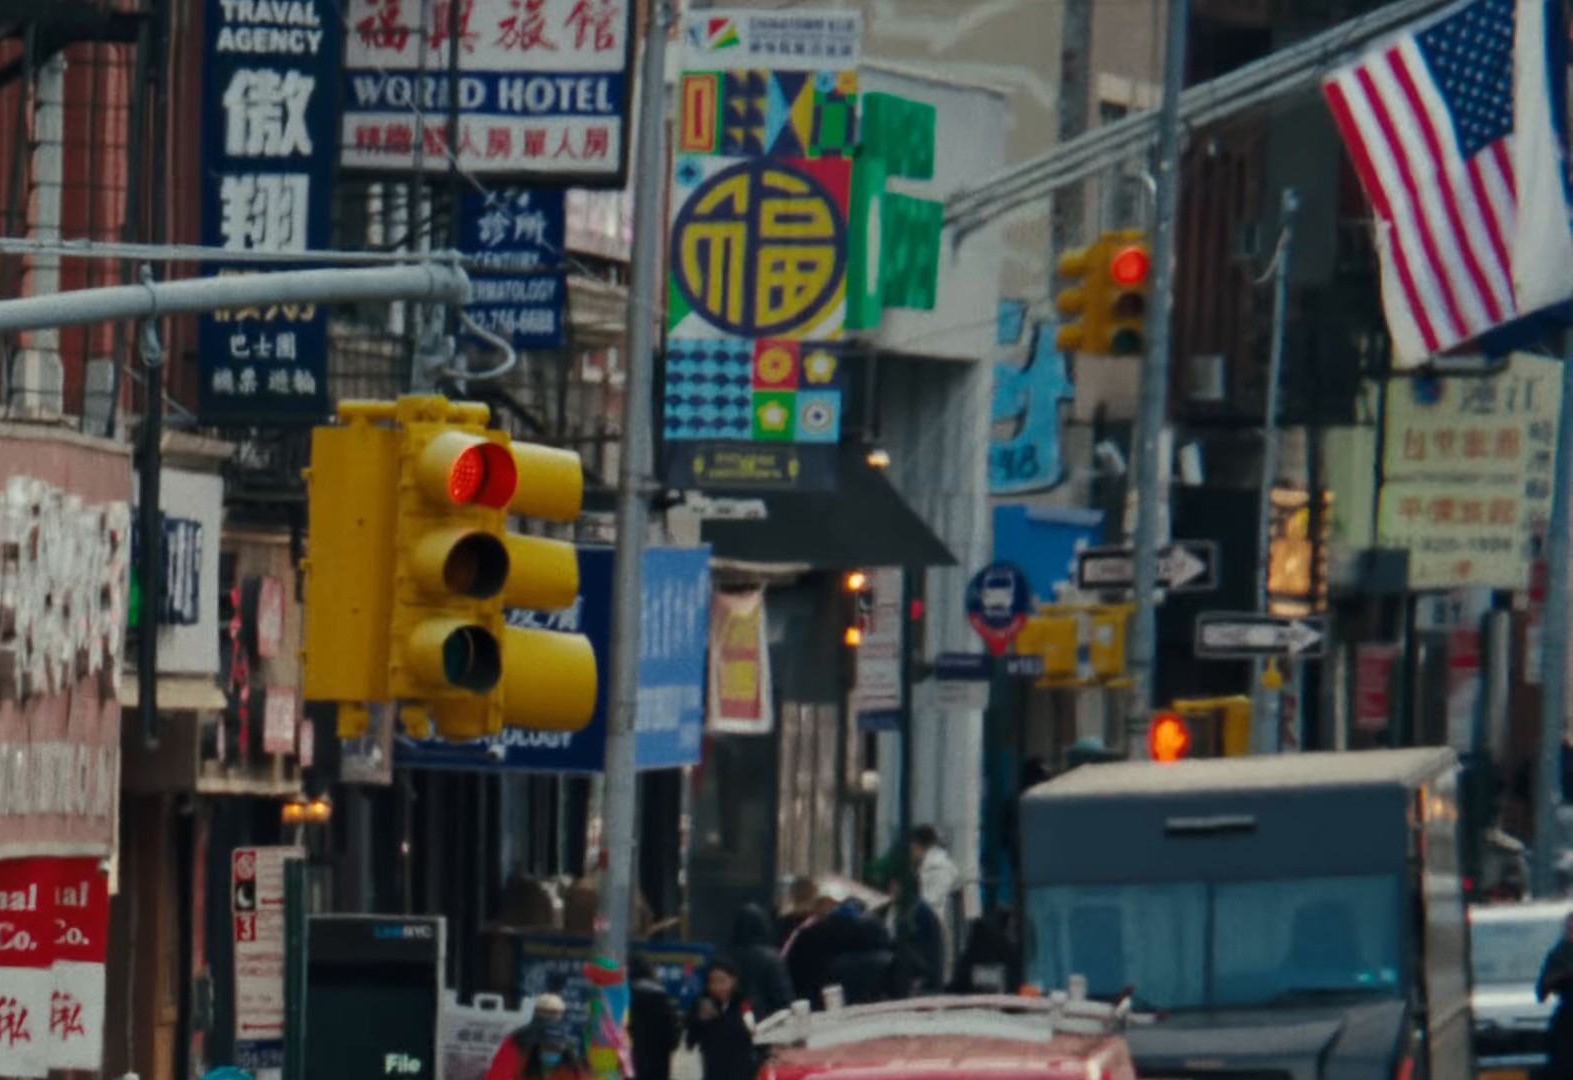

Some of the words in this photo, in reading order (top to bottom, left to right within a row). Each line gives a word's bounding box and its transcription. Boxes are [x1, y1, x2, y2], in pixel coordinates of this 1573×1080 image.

[217, 27, 323, 54] AGENCY
[353, 75, 487, 109] WORLD
[497, 78, 614, 111] HOTEL
[471, 279, 557, 302] ERMATOLOGY
[384, 1053, 422, 1074] File
